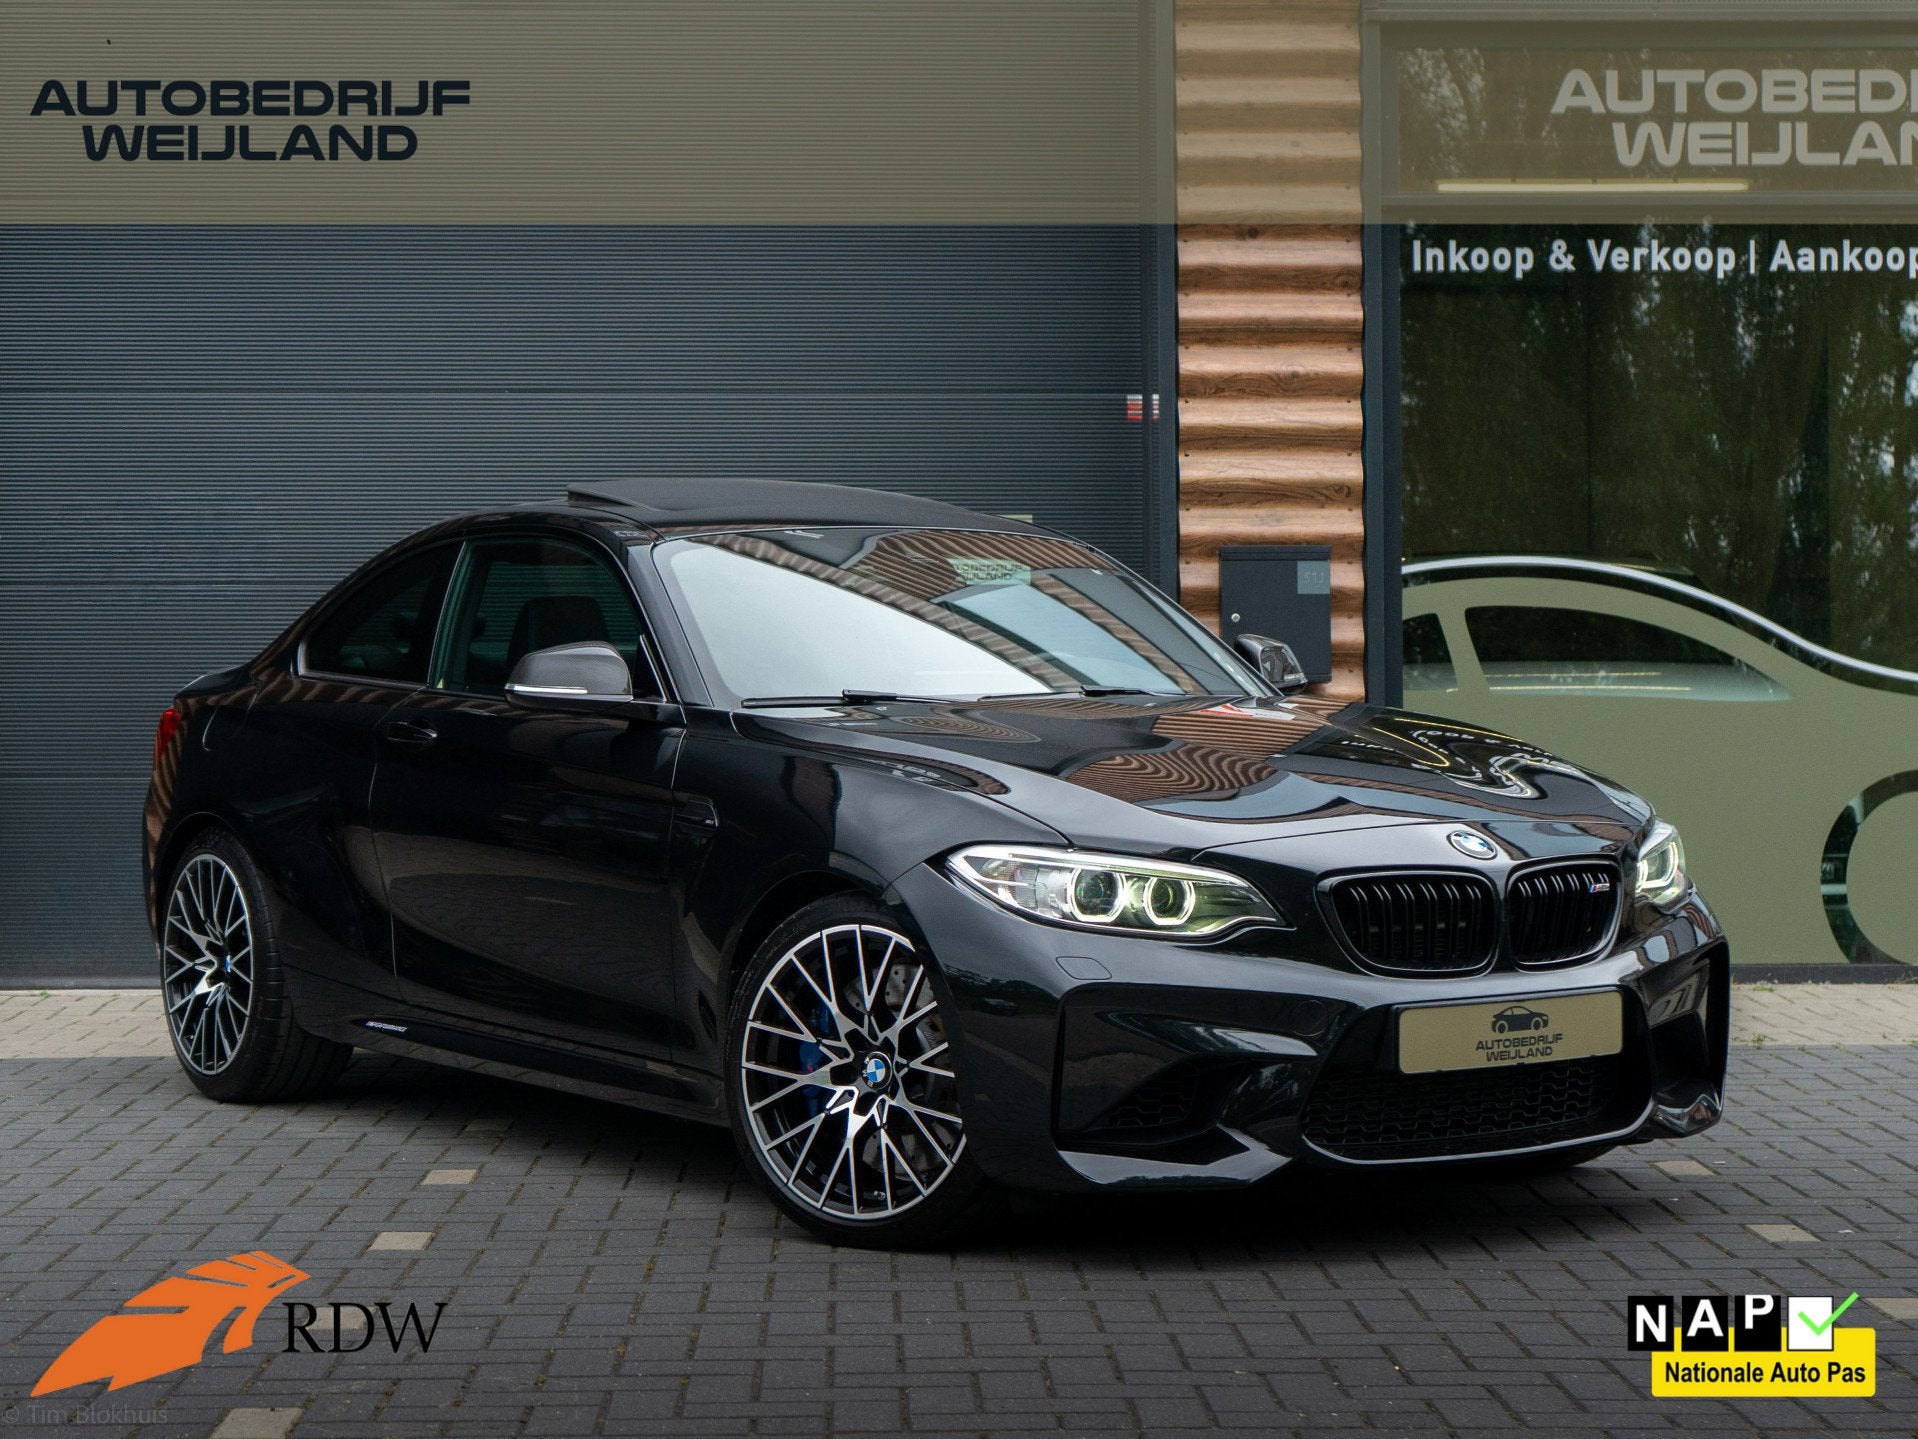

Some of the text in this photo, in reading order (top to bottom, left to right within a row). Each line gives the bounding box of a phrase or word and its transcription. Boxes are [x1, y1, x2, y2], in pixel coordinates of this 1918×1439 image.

[1551, 69, 1918, 115] AUTOBED
[1413, 240, 1534, 279] Inkoop
[1549, 240, 1575, 271] &
[1588, 240, 1737, 280] Verkoop
[1475, 1033, 1563, 1051] AUTOBEDRIJF
[1486, 1046, 1553, 1062] WEIJLAND
